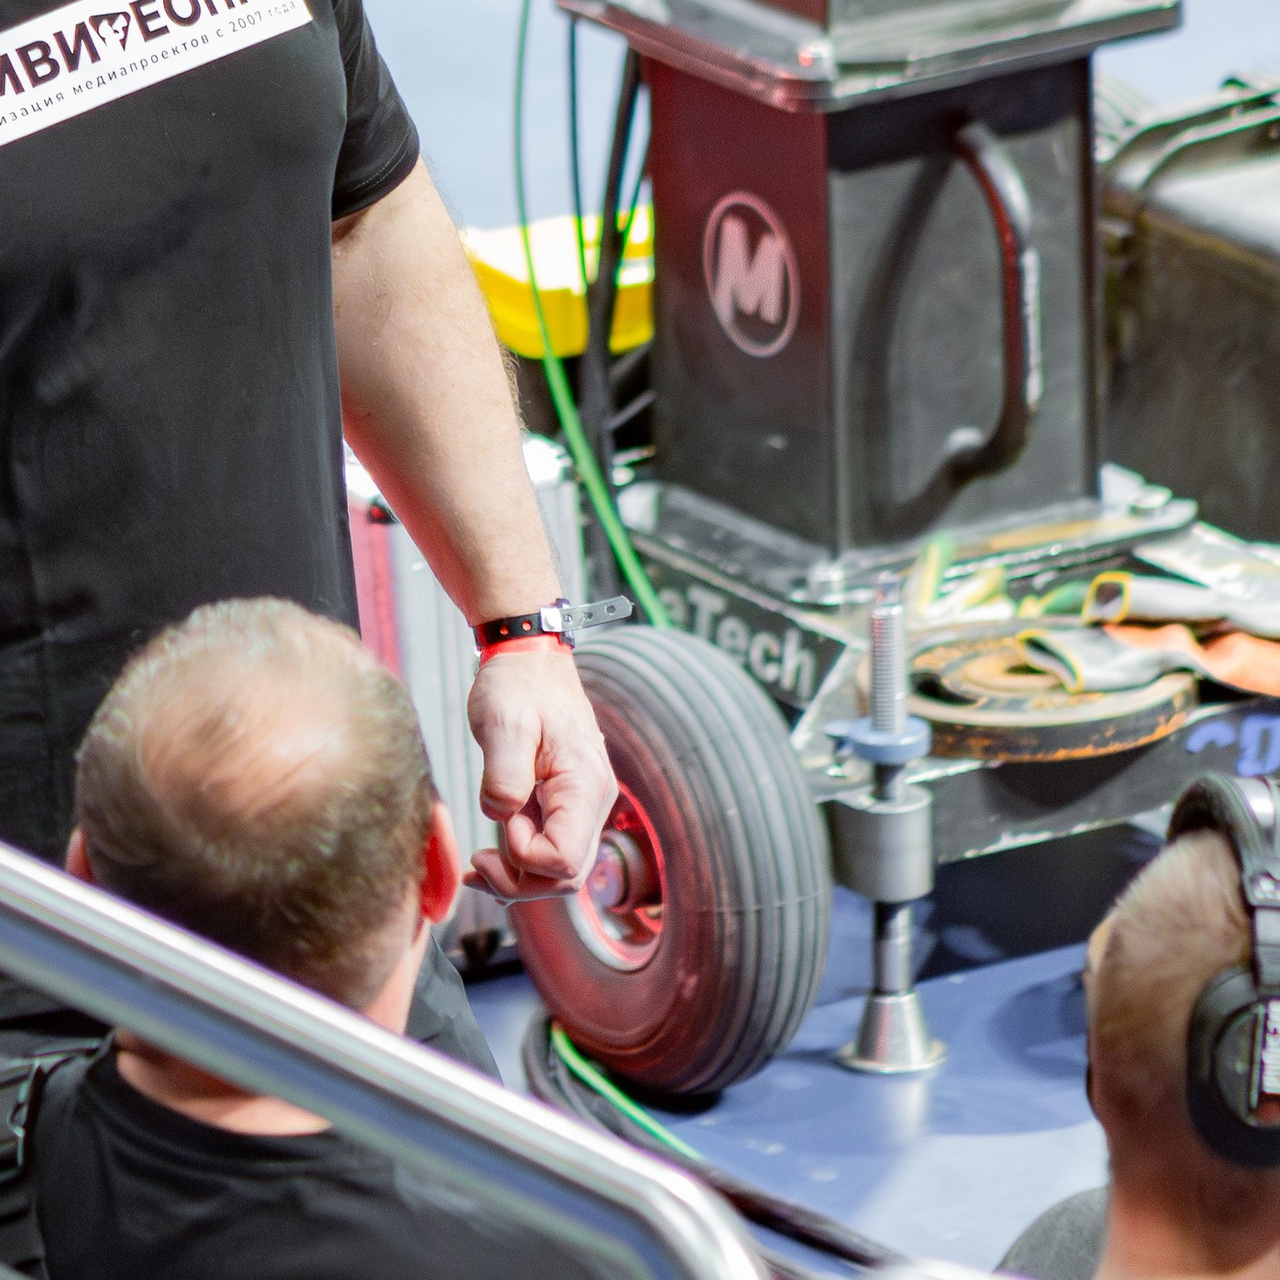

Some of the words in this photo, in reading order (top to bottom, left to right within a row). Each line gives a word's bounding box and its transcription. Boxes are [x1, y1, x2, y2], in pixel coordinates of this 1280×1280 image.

[73, 34, 209, 95] медиапроектов
[216, 27, 224, 37] с
[229, 11, 263, 32] 2007
[711, 212, 787, 329] M
